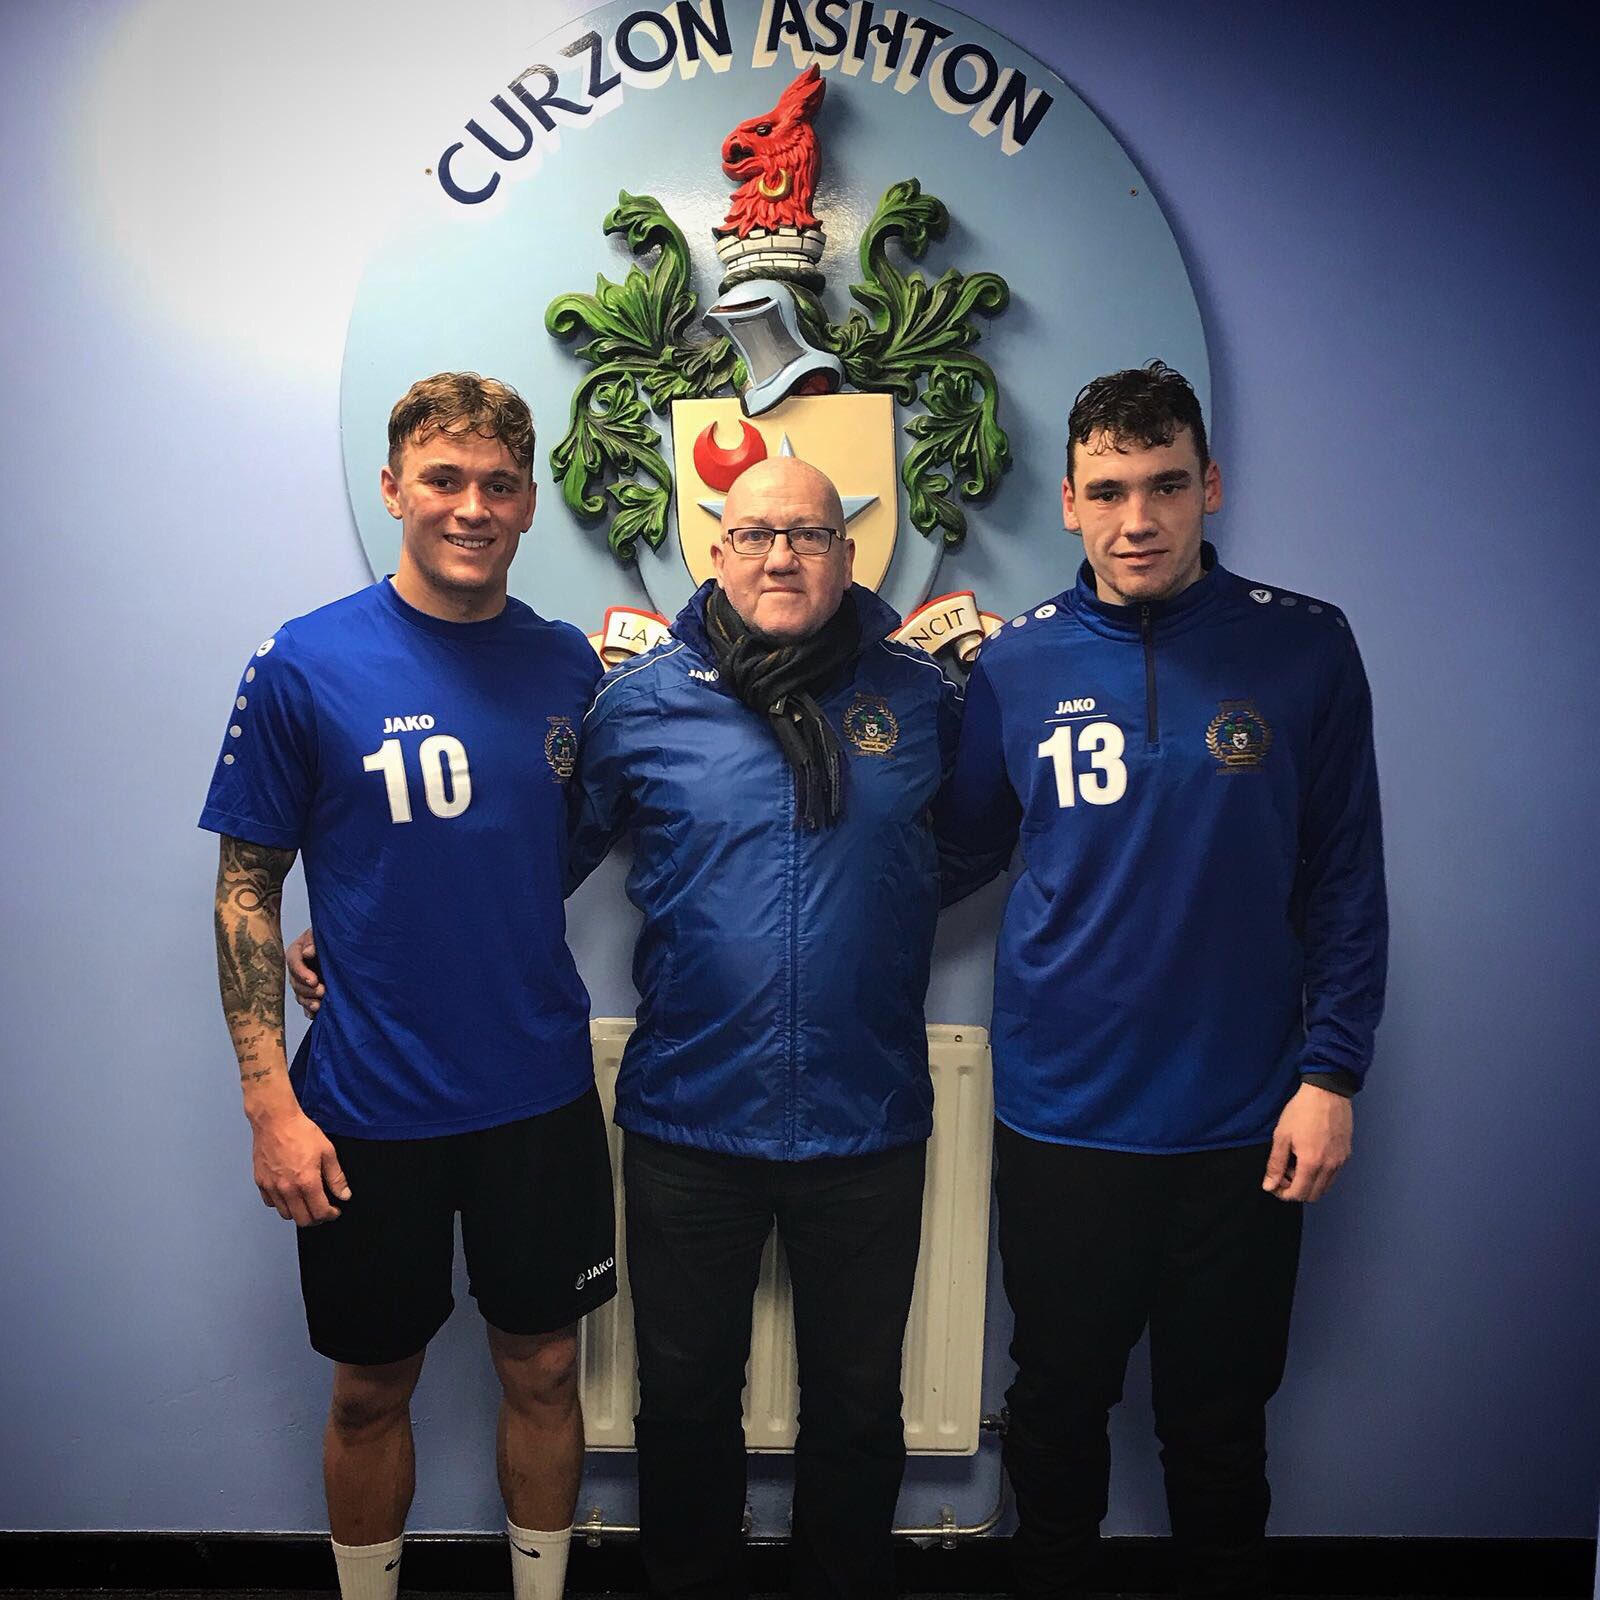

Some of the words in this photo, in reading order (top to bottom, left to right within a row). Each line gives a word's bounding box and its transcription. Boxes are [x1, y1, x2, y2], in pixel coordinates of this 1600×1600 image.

[437, 0, 734, 206] CURZON
[763, 0, 1055, 148] ASHTON
[905, 607, 966, 650] NCIT
[383, 714, 435, 734] JAKO
[1055, 697, 1096, 715] JAKO
[362, 734, 473, 825] 10
[1037, 721, 1128, 809] 13
[586, 1256, 614, 1281] JAKO
